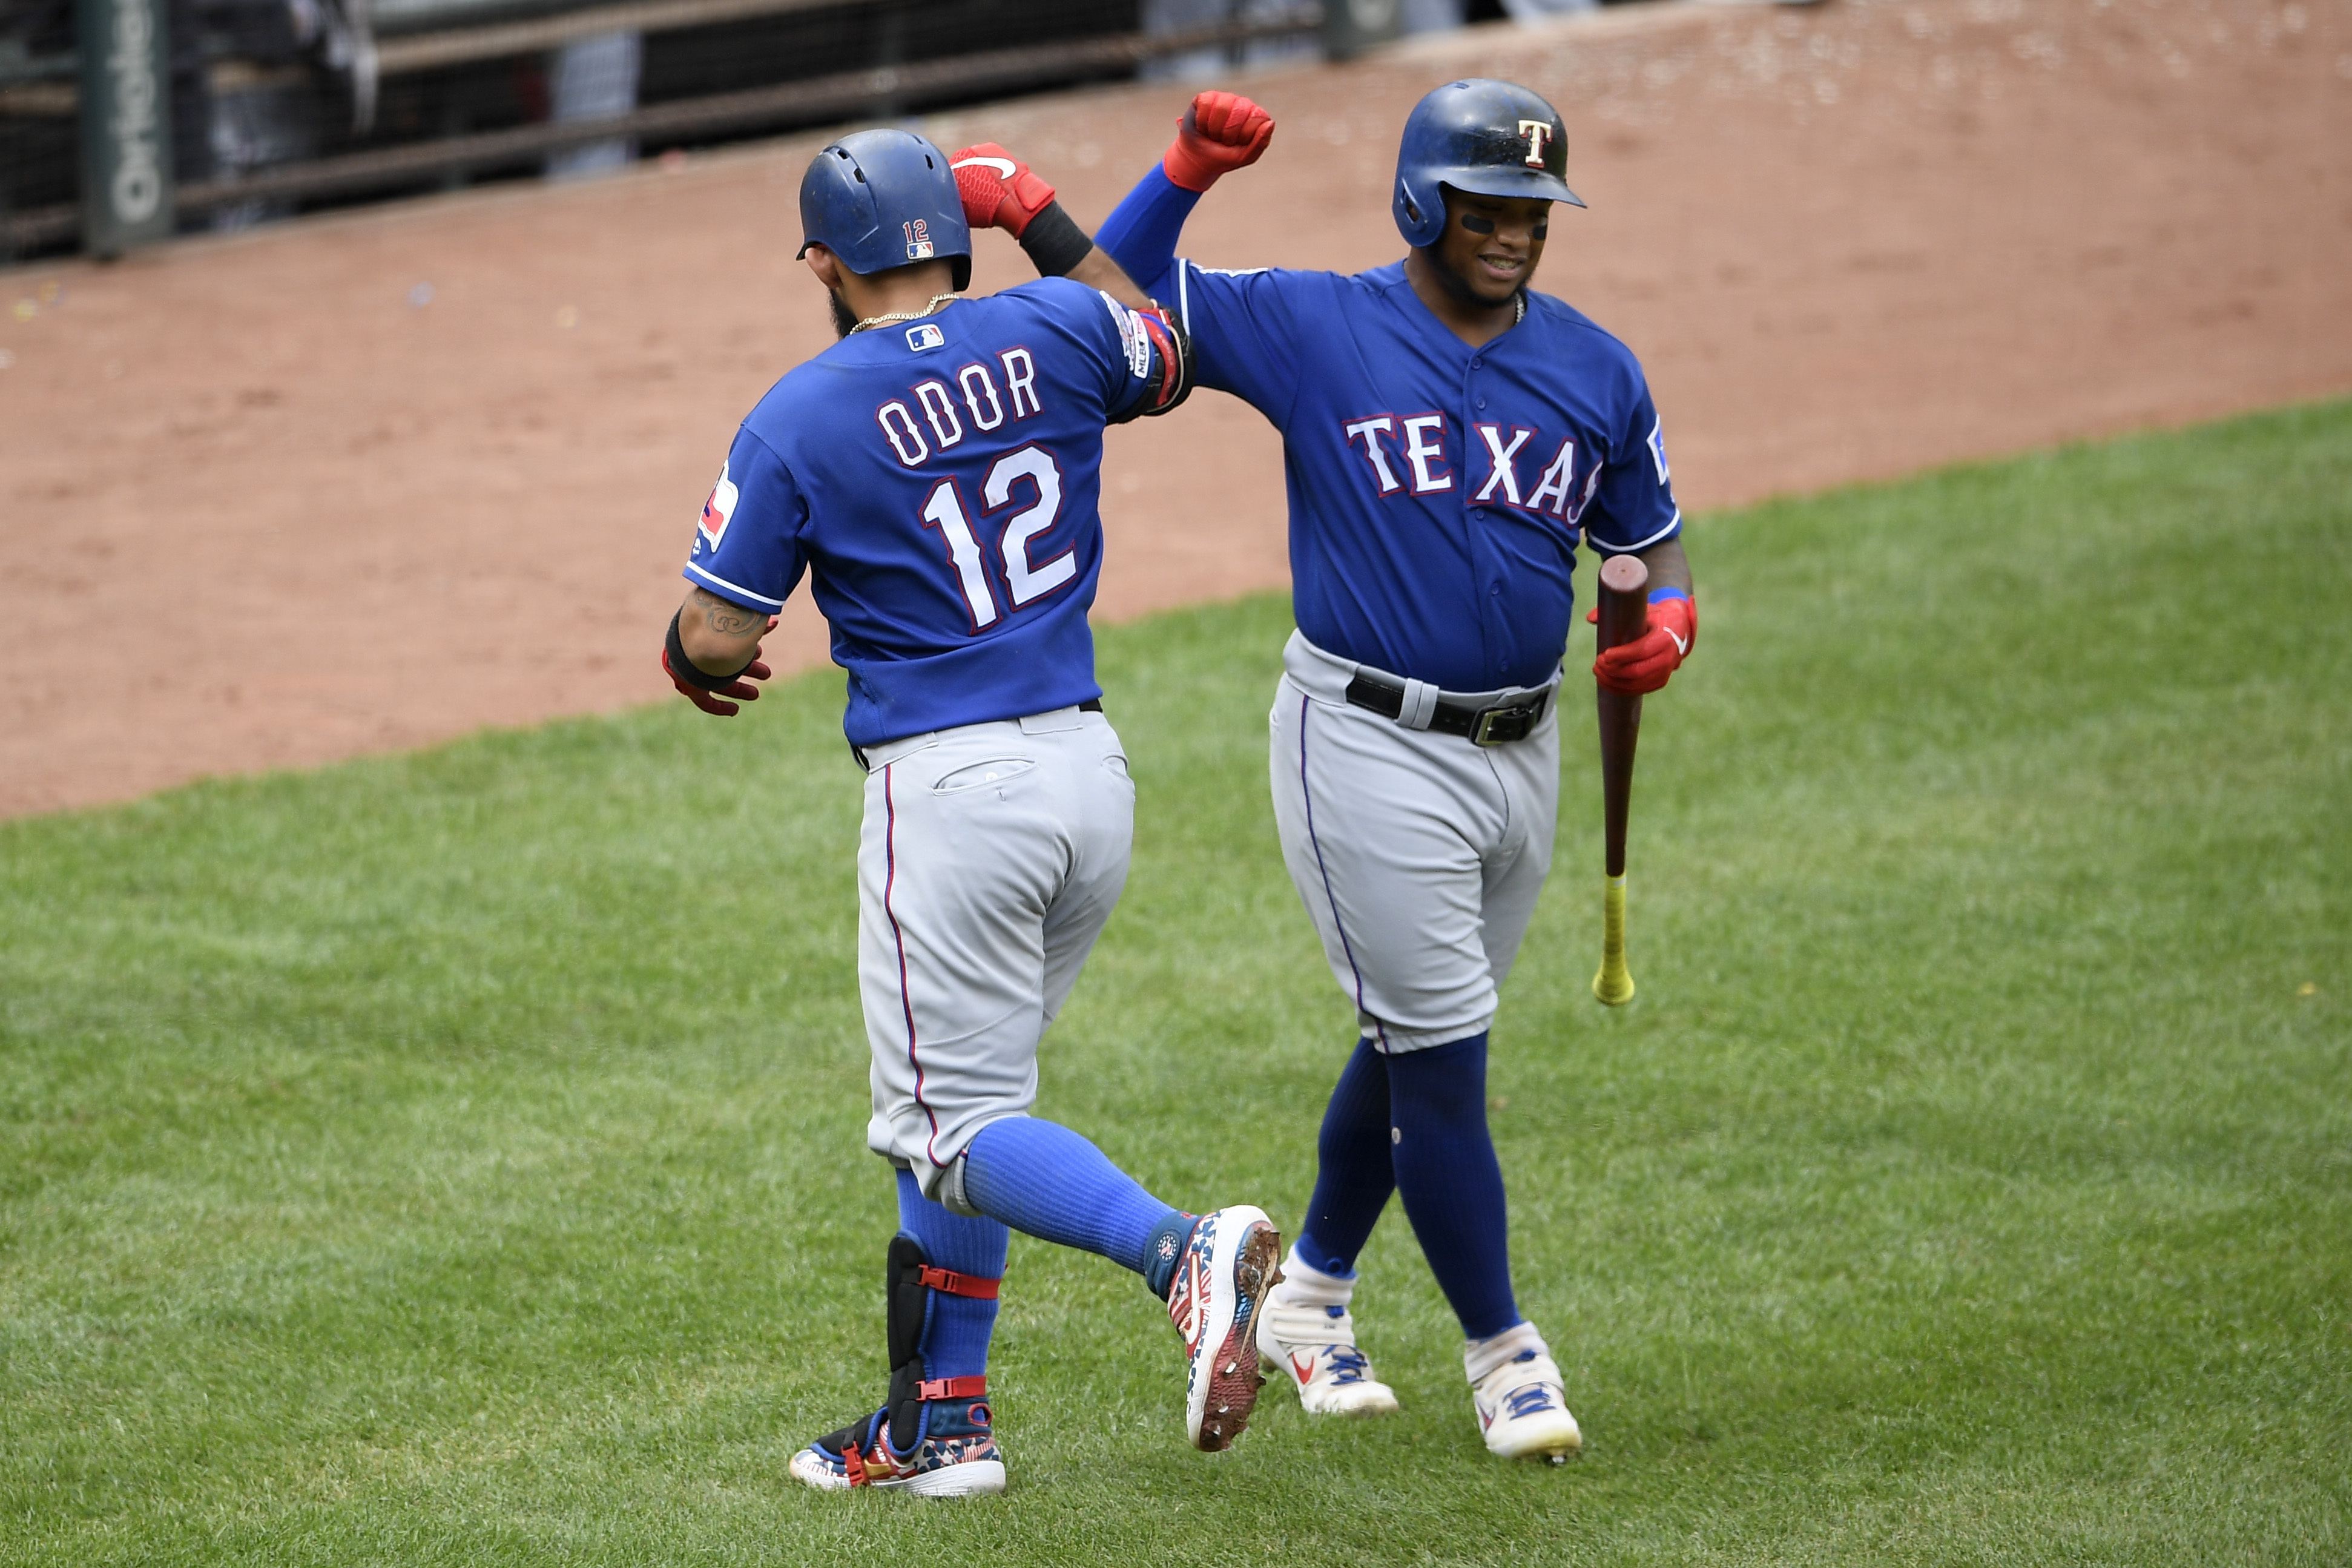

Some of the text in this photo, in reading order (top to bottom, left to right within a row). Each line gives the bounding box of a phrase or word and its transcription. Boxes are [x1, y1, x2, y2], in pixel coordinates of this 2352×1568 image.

[1518, 120, 1553, 168] T
[903, 219, 929, 243] 12
[875, 345, 1044, 469] ODOR
[918, 440, 1078, 636] 12
